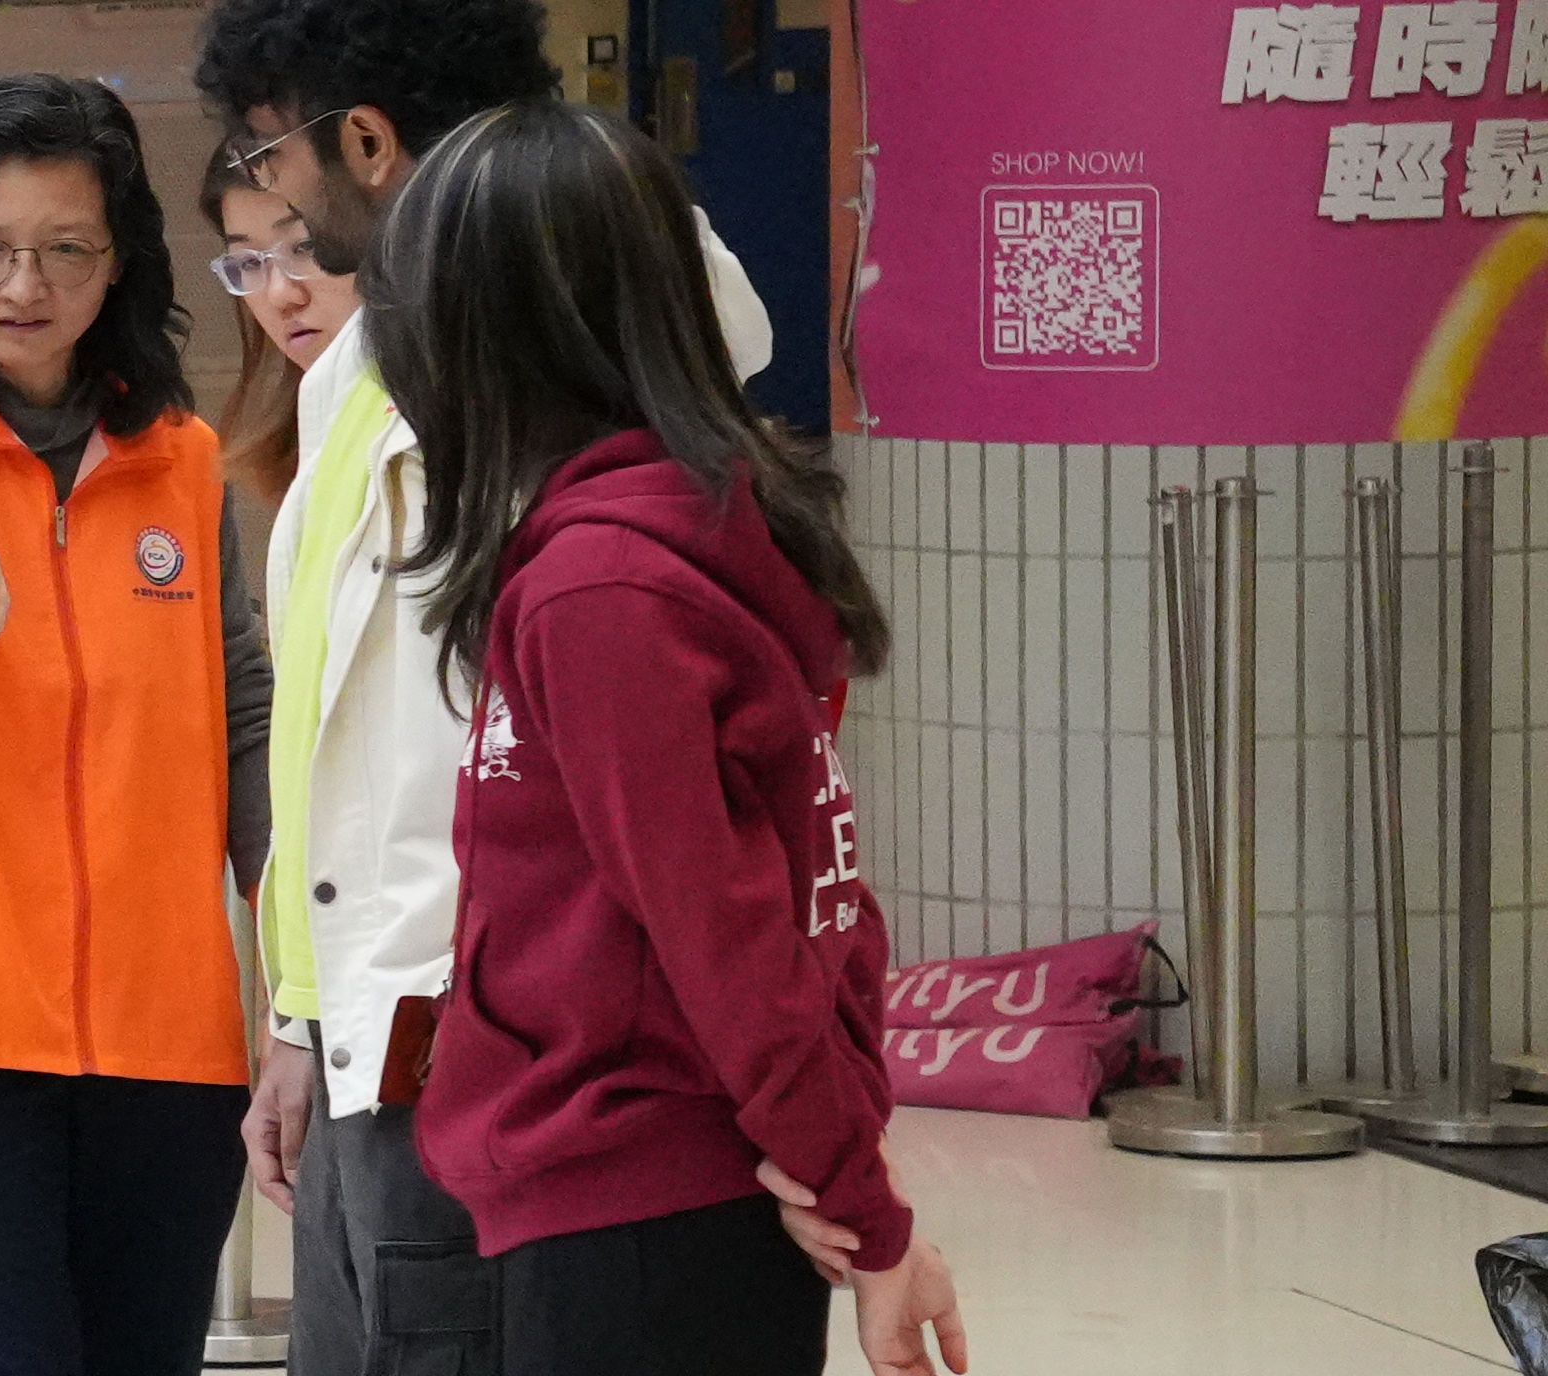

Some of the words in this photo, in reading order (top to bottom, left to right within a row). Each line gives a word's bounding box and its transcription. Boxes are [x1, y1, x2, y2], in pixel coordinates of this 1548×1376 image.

[990, 151, 1059, 177] SHOP
[1066, 148, 1145, 175] NOW!
[886, 961, 1050, 1021] ityU
